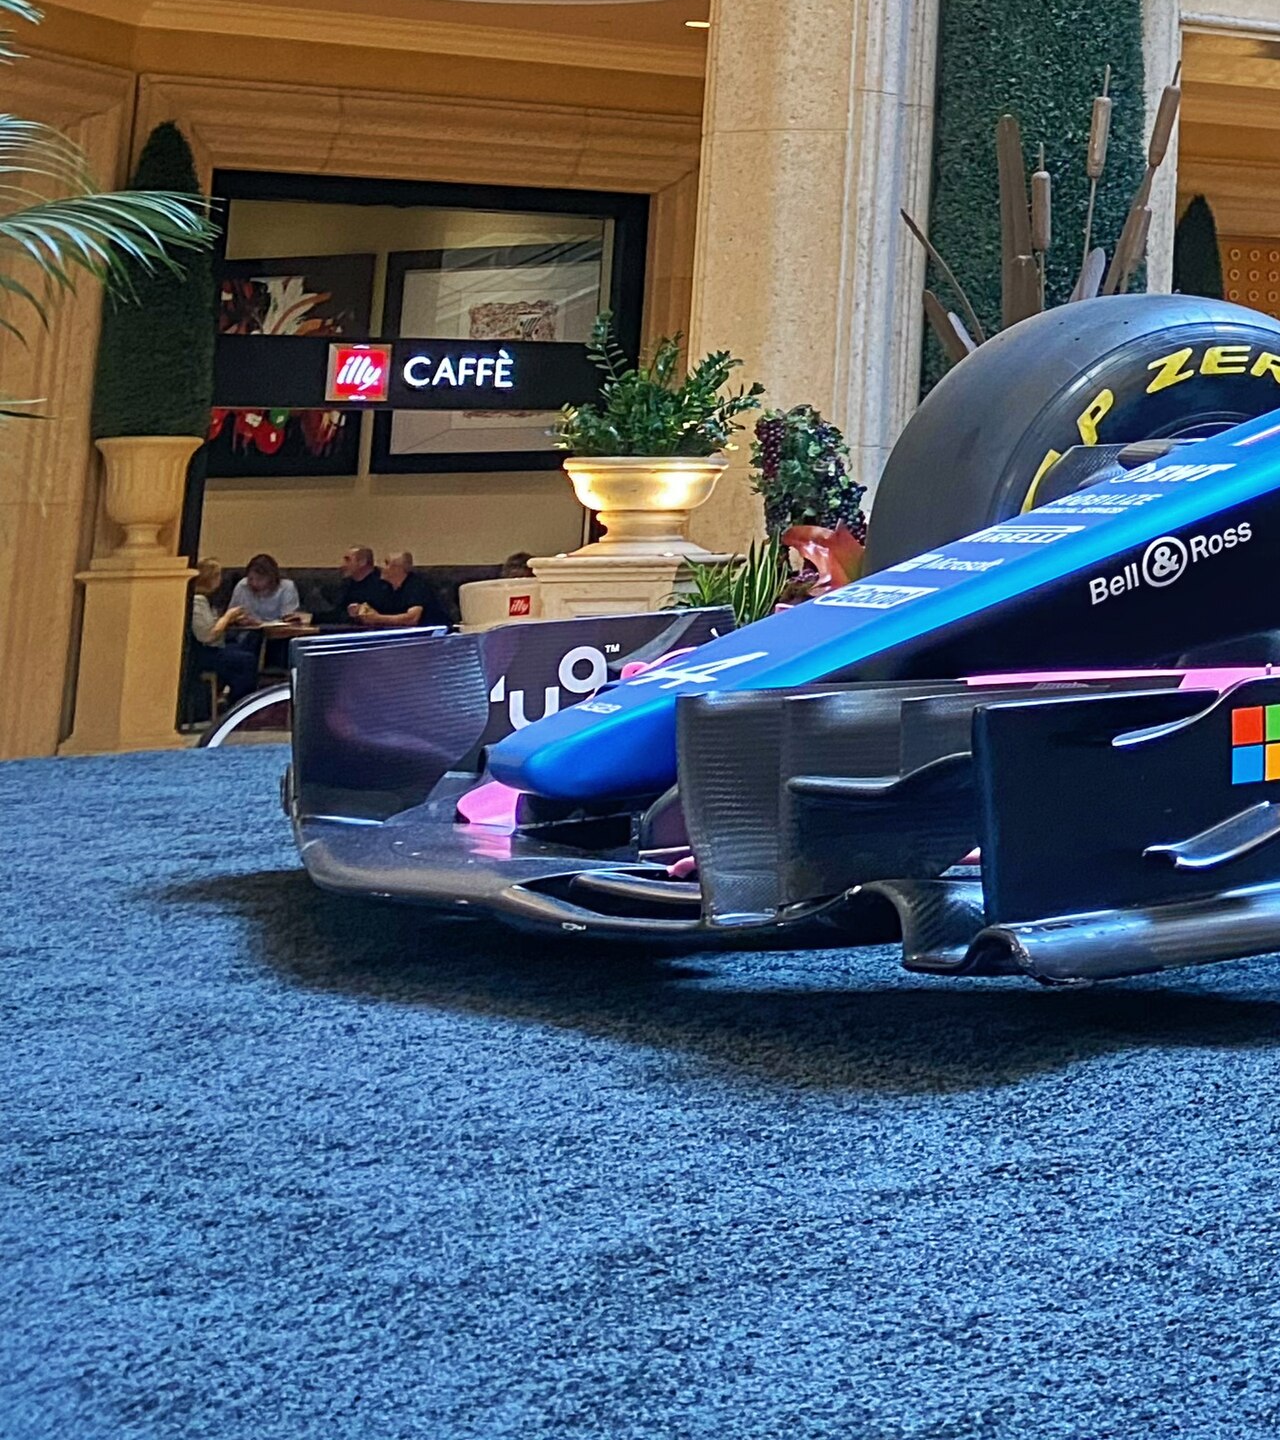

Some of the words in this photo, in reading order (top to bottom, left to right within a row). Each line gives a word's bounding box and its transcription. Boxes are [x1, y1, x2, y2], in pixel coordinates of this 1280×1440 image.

[336, 356, 382, 391] illy
[403, 349, 514, 388] CAFFÈ
[957, 525, 1087, 543] PIRELLI
[1089, 562, 1140, 605] Bell
[1189, 521, 1253, 563] Ross
[510, 599, 529, 615] illy
